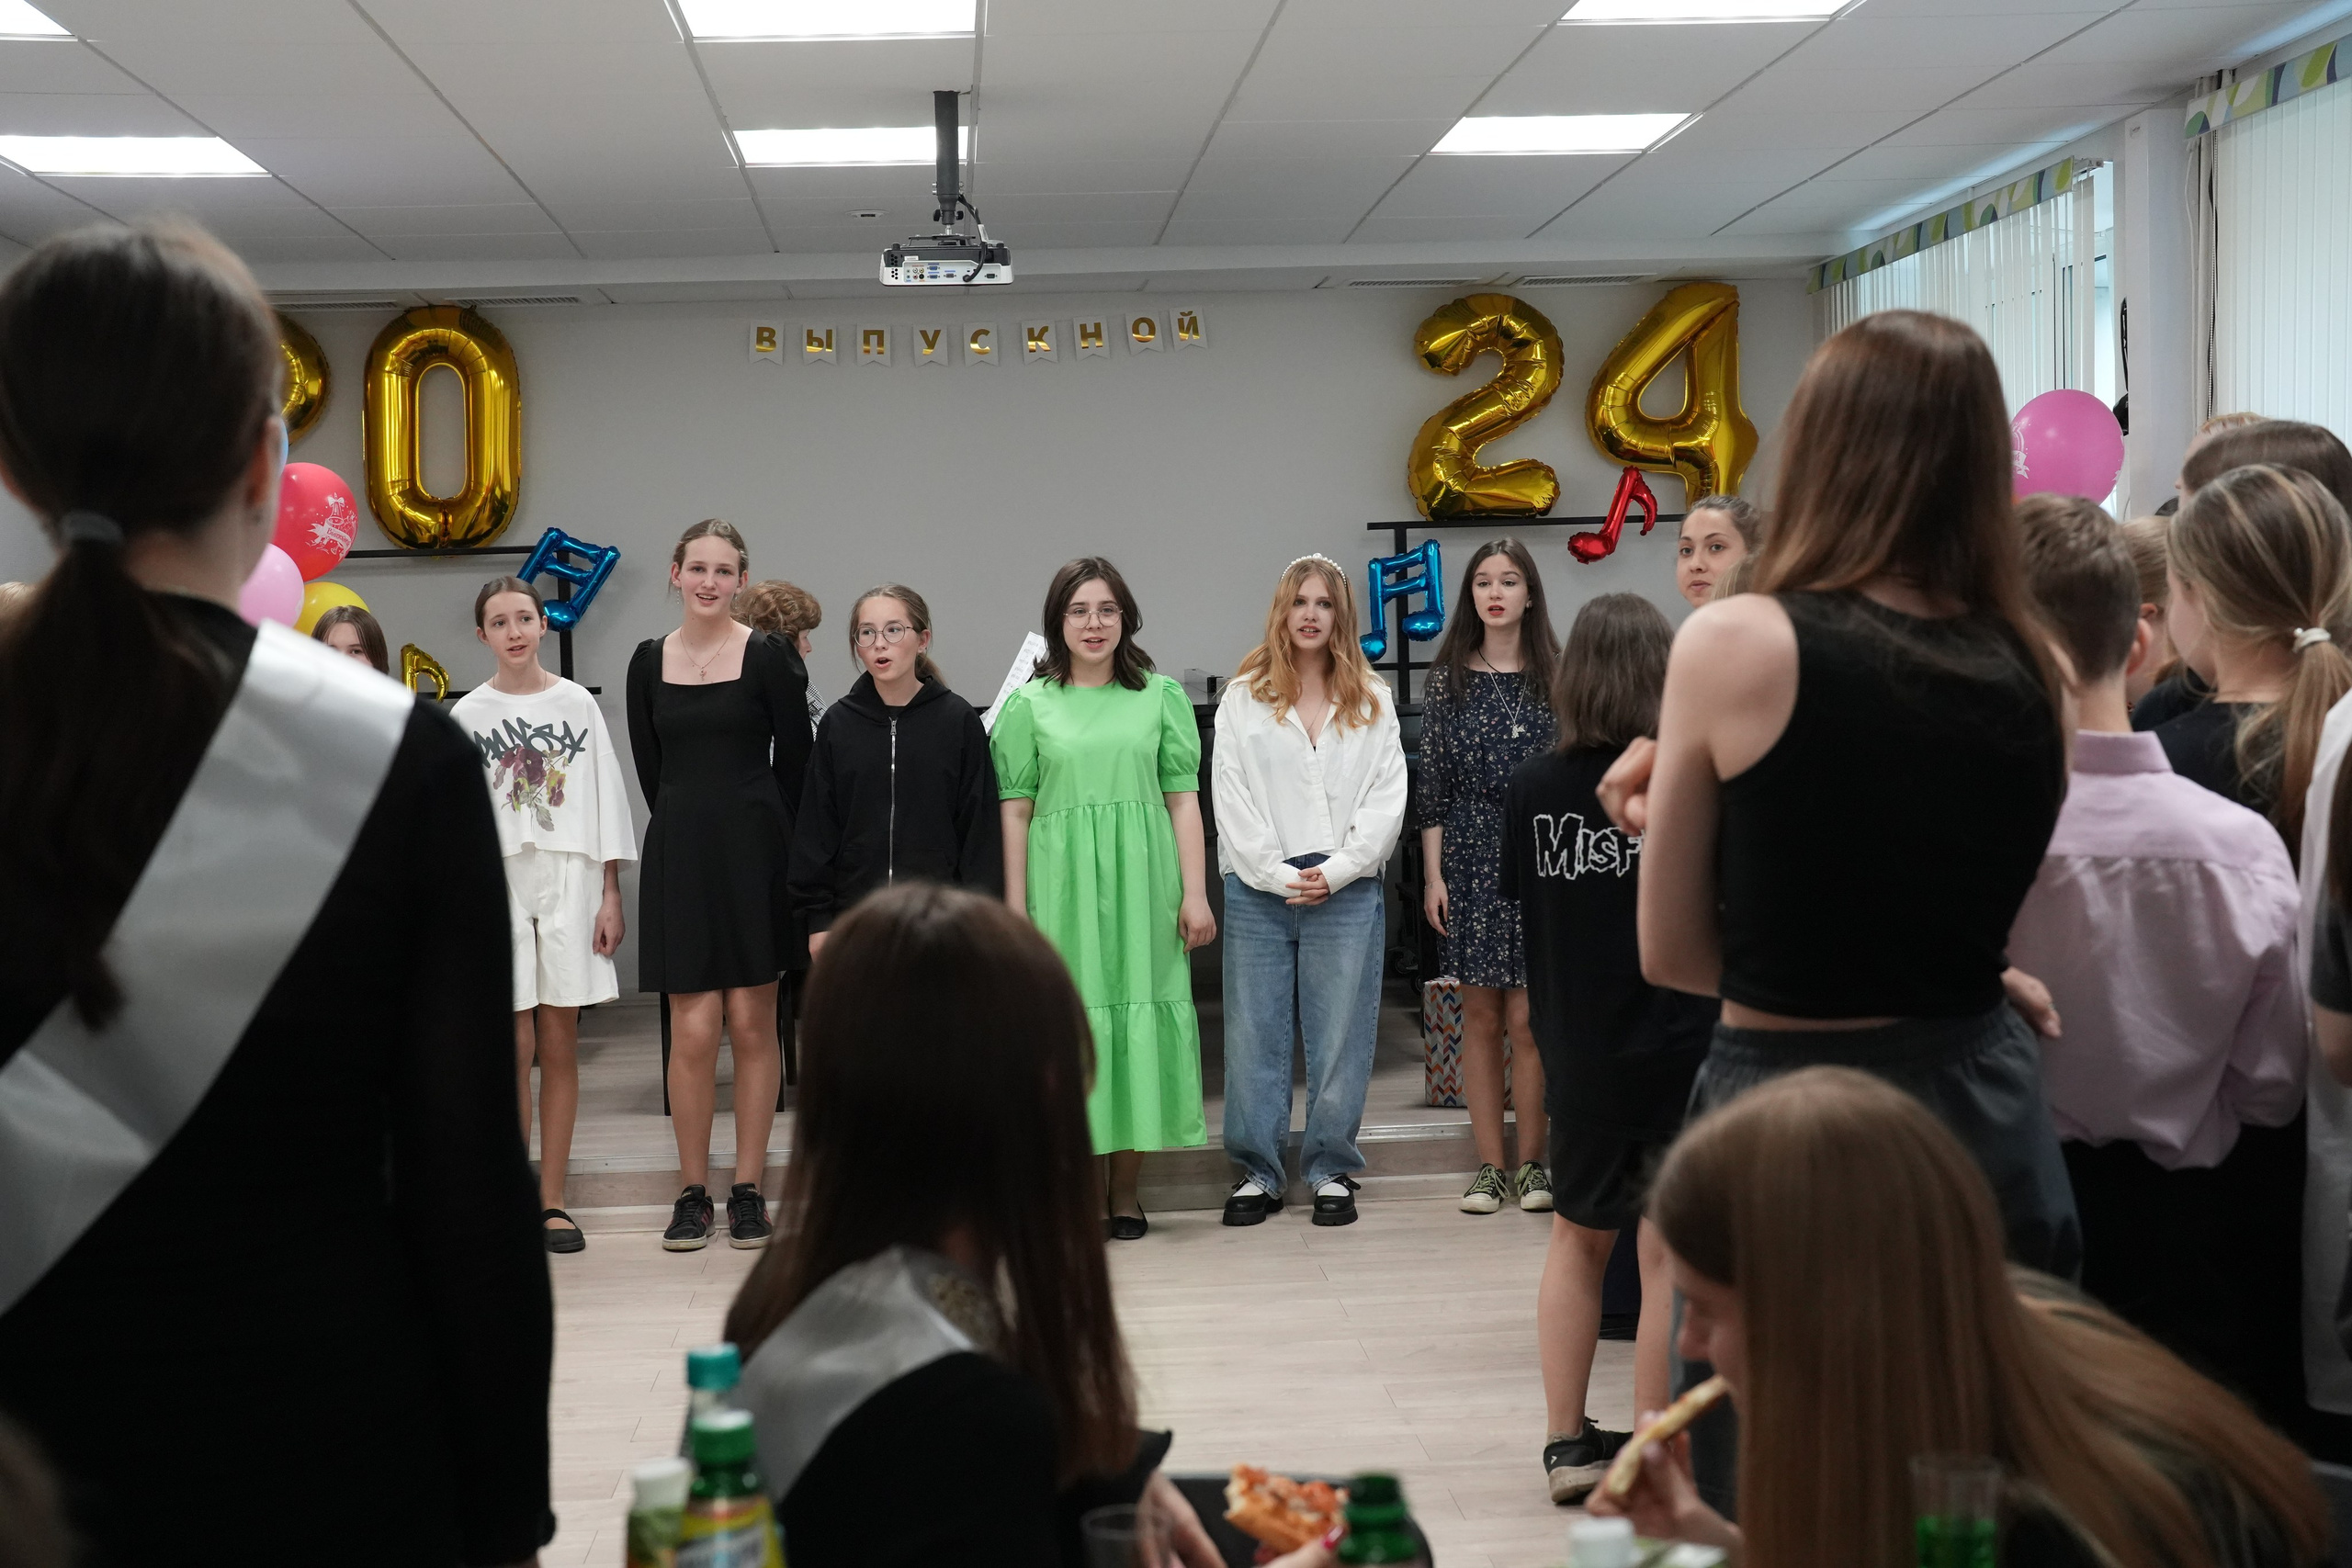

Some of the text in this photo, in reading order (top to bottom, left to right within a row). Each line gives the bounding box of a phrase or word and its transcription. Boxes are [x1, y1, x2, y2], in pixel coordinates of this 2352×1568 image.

[754, 310, 1201, 355] ВЫПУСКНОЙ
[1408, 282, 1758, 521] 24
[1533, 813, 1645, 880] MISF
